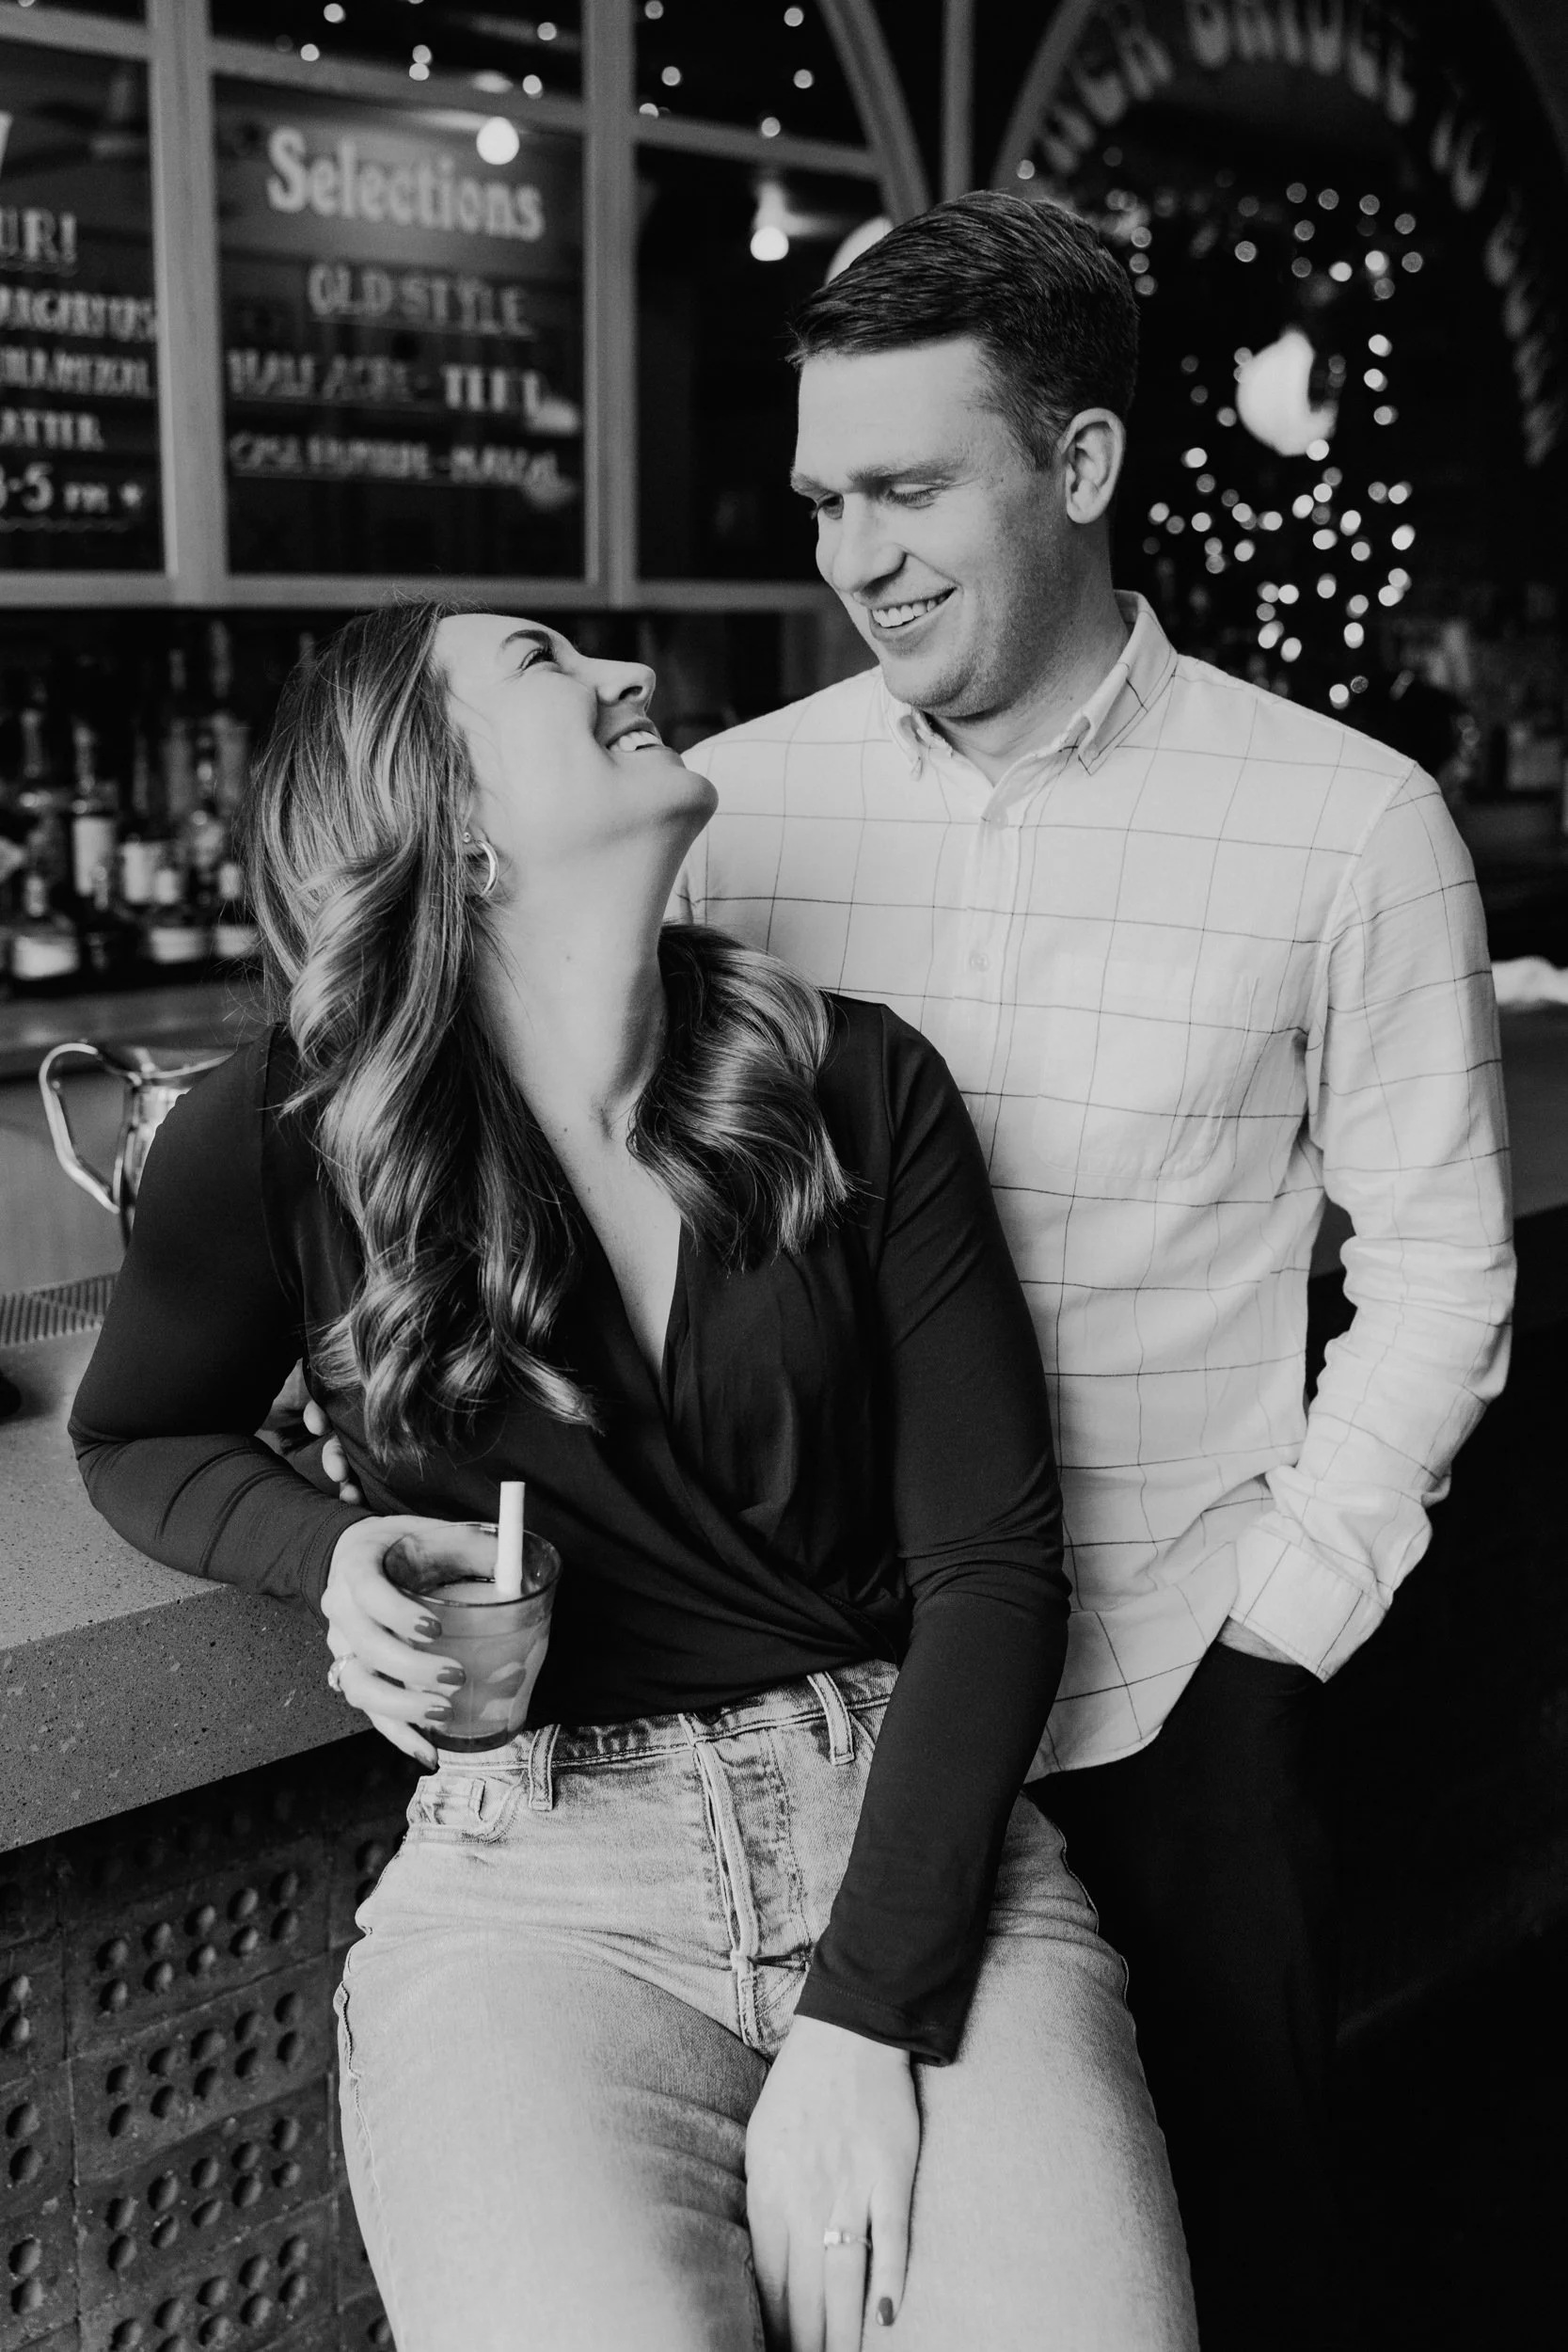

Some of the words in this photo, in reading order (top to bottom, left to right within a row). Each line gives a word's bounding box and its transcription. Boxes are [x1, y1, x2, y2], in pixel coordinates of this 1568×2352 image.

[266, 125, 545, 242] Selections
[307, 263, 393, 318] OLD
[399, 275, 534, 339] STYLE
[0, 461, 53, 513] -5
